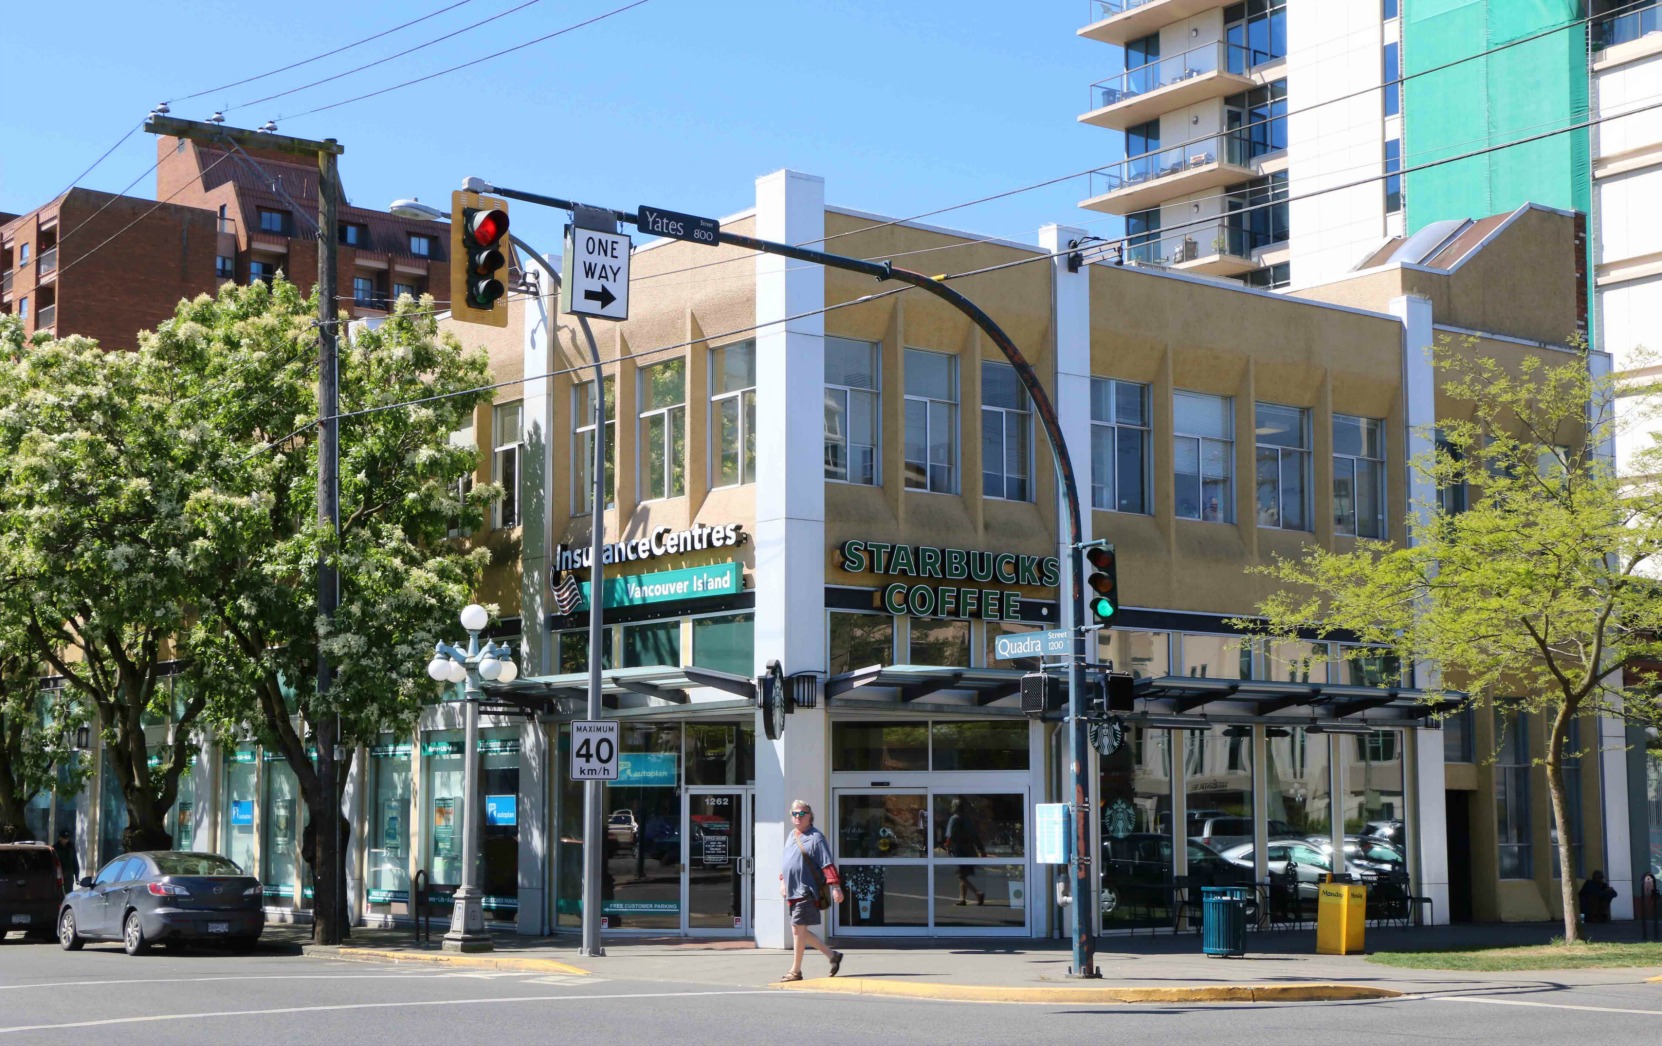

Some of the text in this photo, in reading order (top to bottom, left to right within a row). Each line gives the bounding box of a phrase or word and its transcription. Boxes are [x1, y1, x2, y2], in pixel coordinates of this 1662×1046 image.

[645, 210, 684, 236] Yates
[700, 219, 713, 228] Street
[693, 228, 713, 241] 800
[585, 236, 619, 259] ONE
[583, 260, 622, 283] WAY
[556, 522, 737, 571] InsuanceCentres
[844, 540, 1060, 587] STARBUCKS
[627, 572, 731, 599] Vancouver Island
[885, 583, 1021, 621] COFFEE
[1047, 631, 1068, 640] Street
[998, 636, 1041, 657] Quadra
[1048, 640, 1064, 651] 1200
[576, 725, 615, 733] MAXIMUM
[575, 738, 614, 764] 40
[579, 766, 610, 776] km/h
[633, 769, 668, 778] autoplan
[704, 797, 729, 806] 1262
[1321, 889, 1344, 900] Monday
